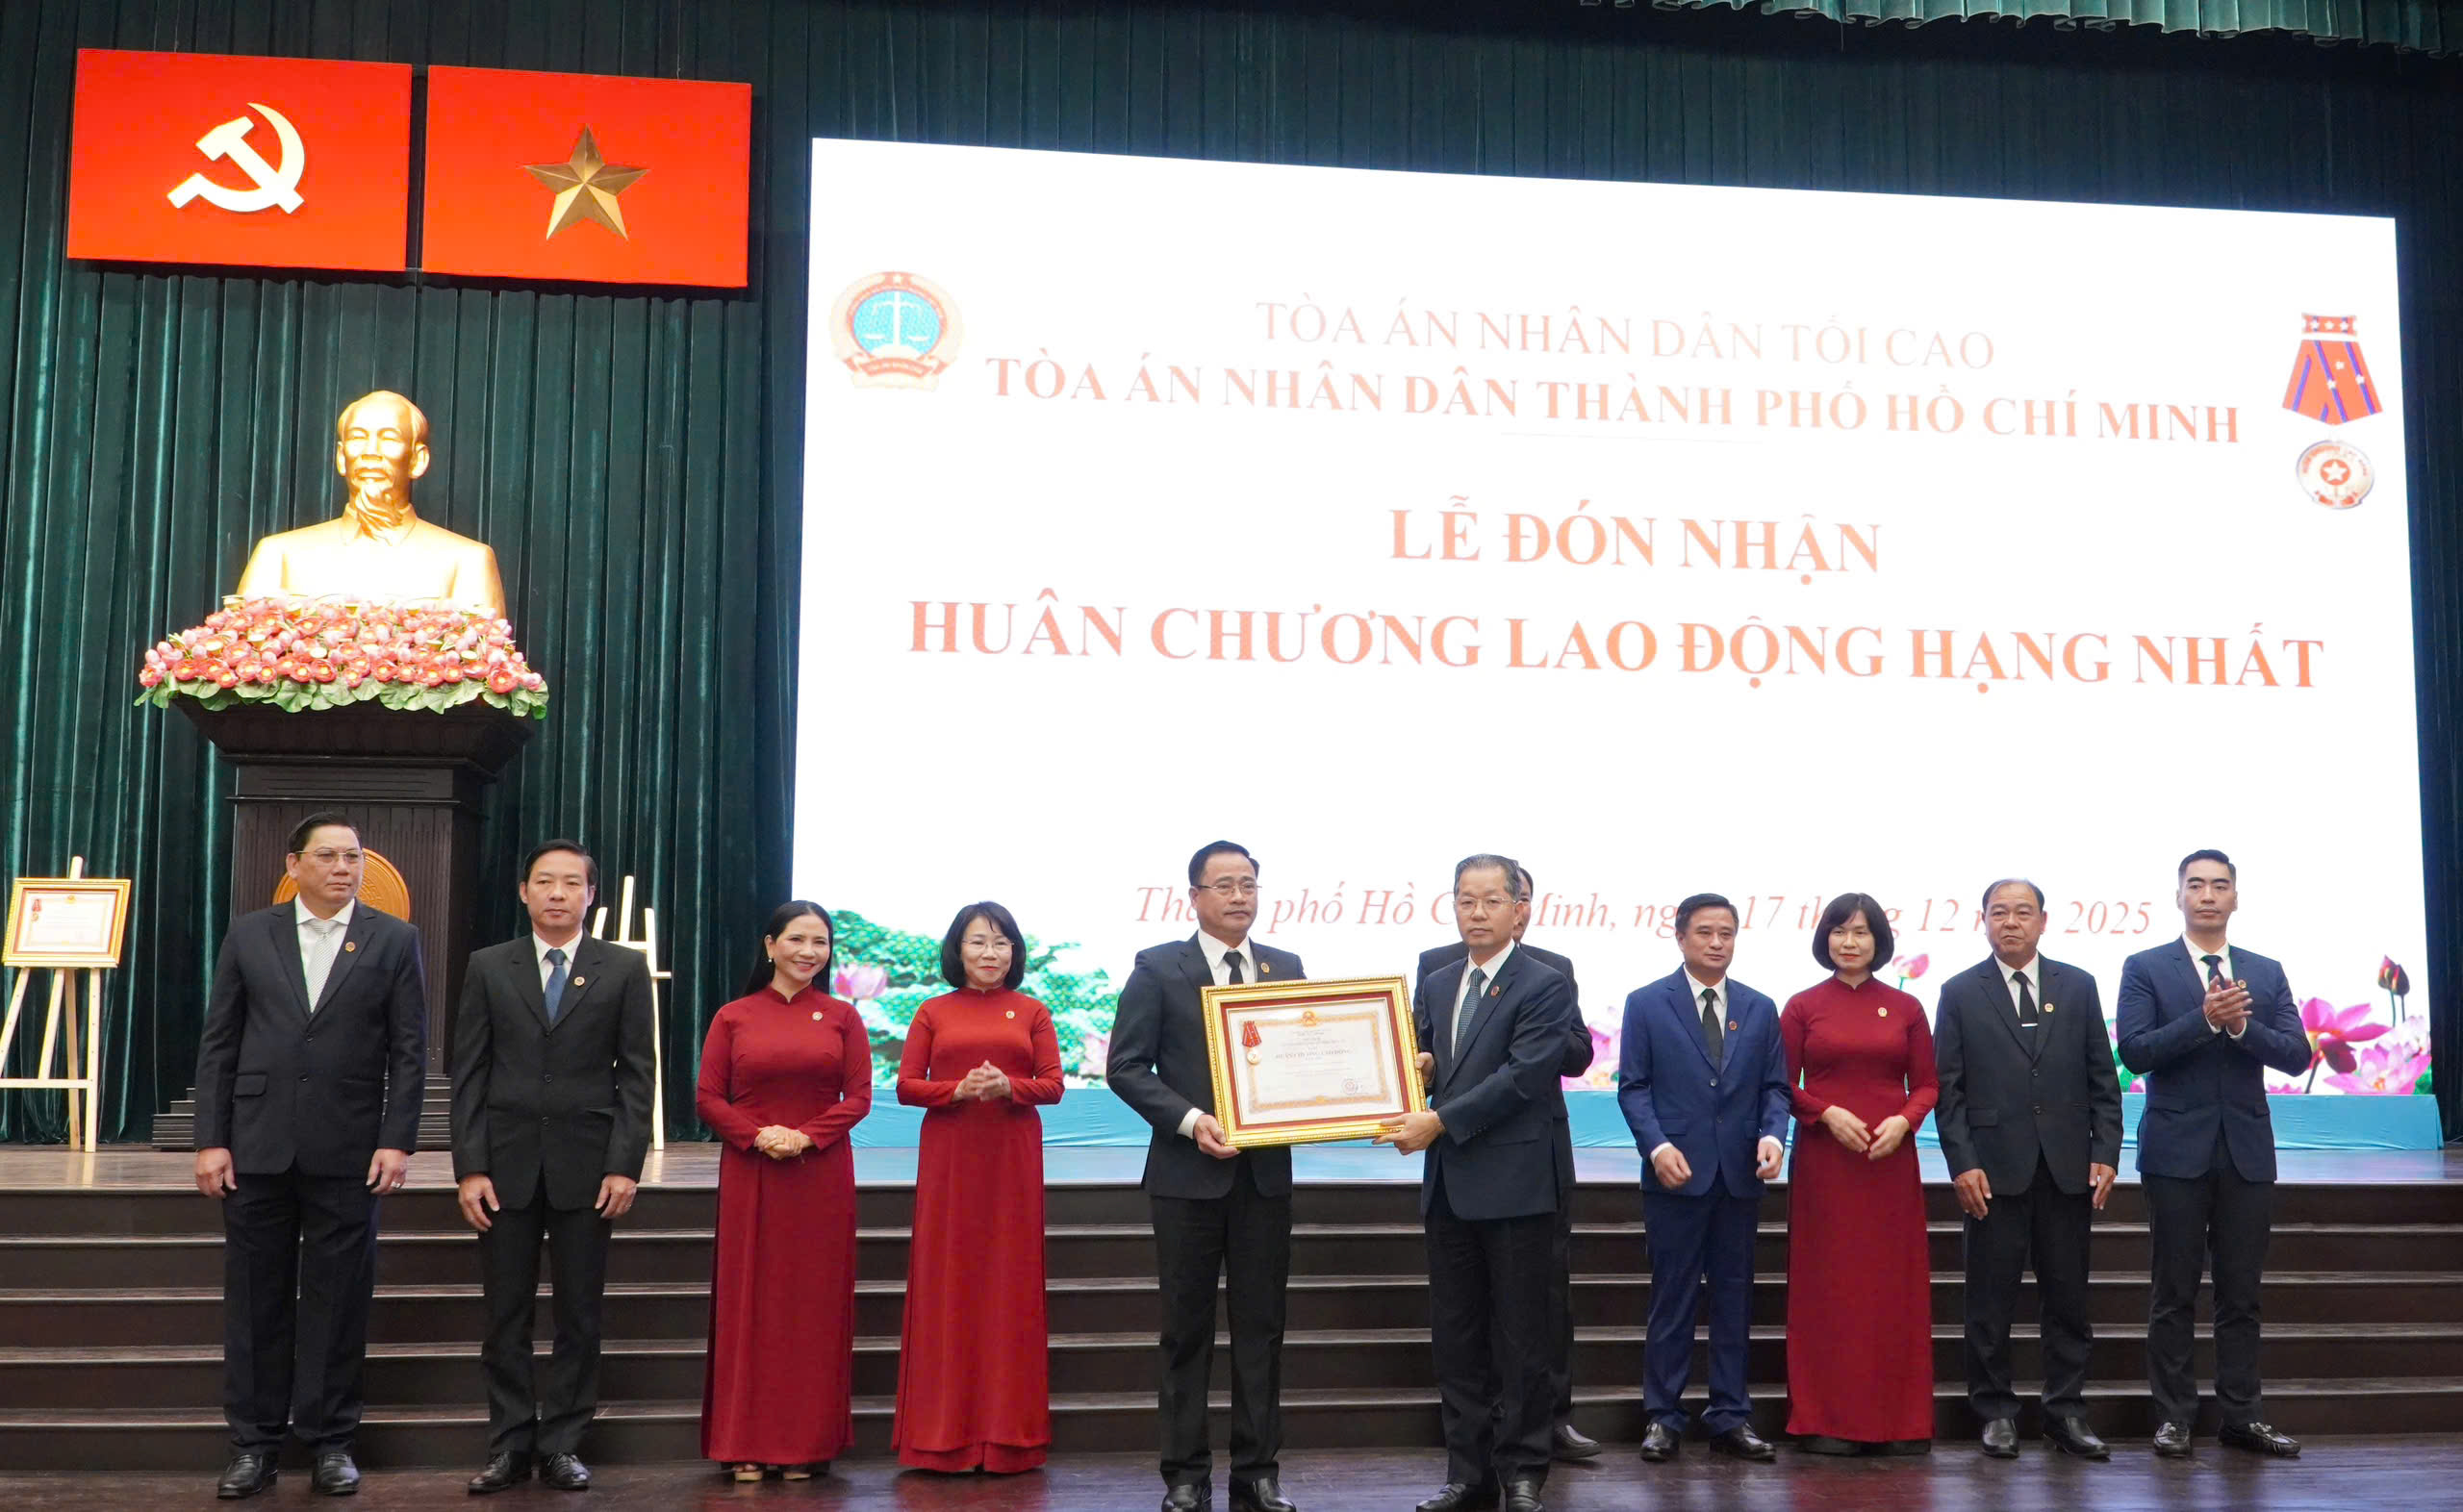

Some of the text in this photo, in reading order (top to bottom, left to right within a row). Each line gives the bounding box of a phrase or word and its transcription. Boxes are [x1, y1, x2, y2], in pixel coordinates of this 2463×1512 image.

[1256, 292, 1994, 369] TÒA ÁN NHÂN DÂN TỐI CAO
[985, 347, 2240, 443] TÒA ÁN NHÂN DÂN THÀNH PHỐ HỒ CHÍ MINH
[1389, 494, 1881, 585] LỄ ĐÓN NHẬN
[908, 587, 2324, 694] HUÂN CHƯƠNG LAO ĐỘNG HẠNG NHẤT
[1266, 881, 1345, 934] phố
[1356, 881, 1414, 924] Hồ
[1740, 895, 1786, 931] 17
[1917, 898, 1961, 932] 12
[2064, 900, 2152, 935] 2025
